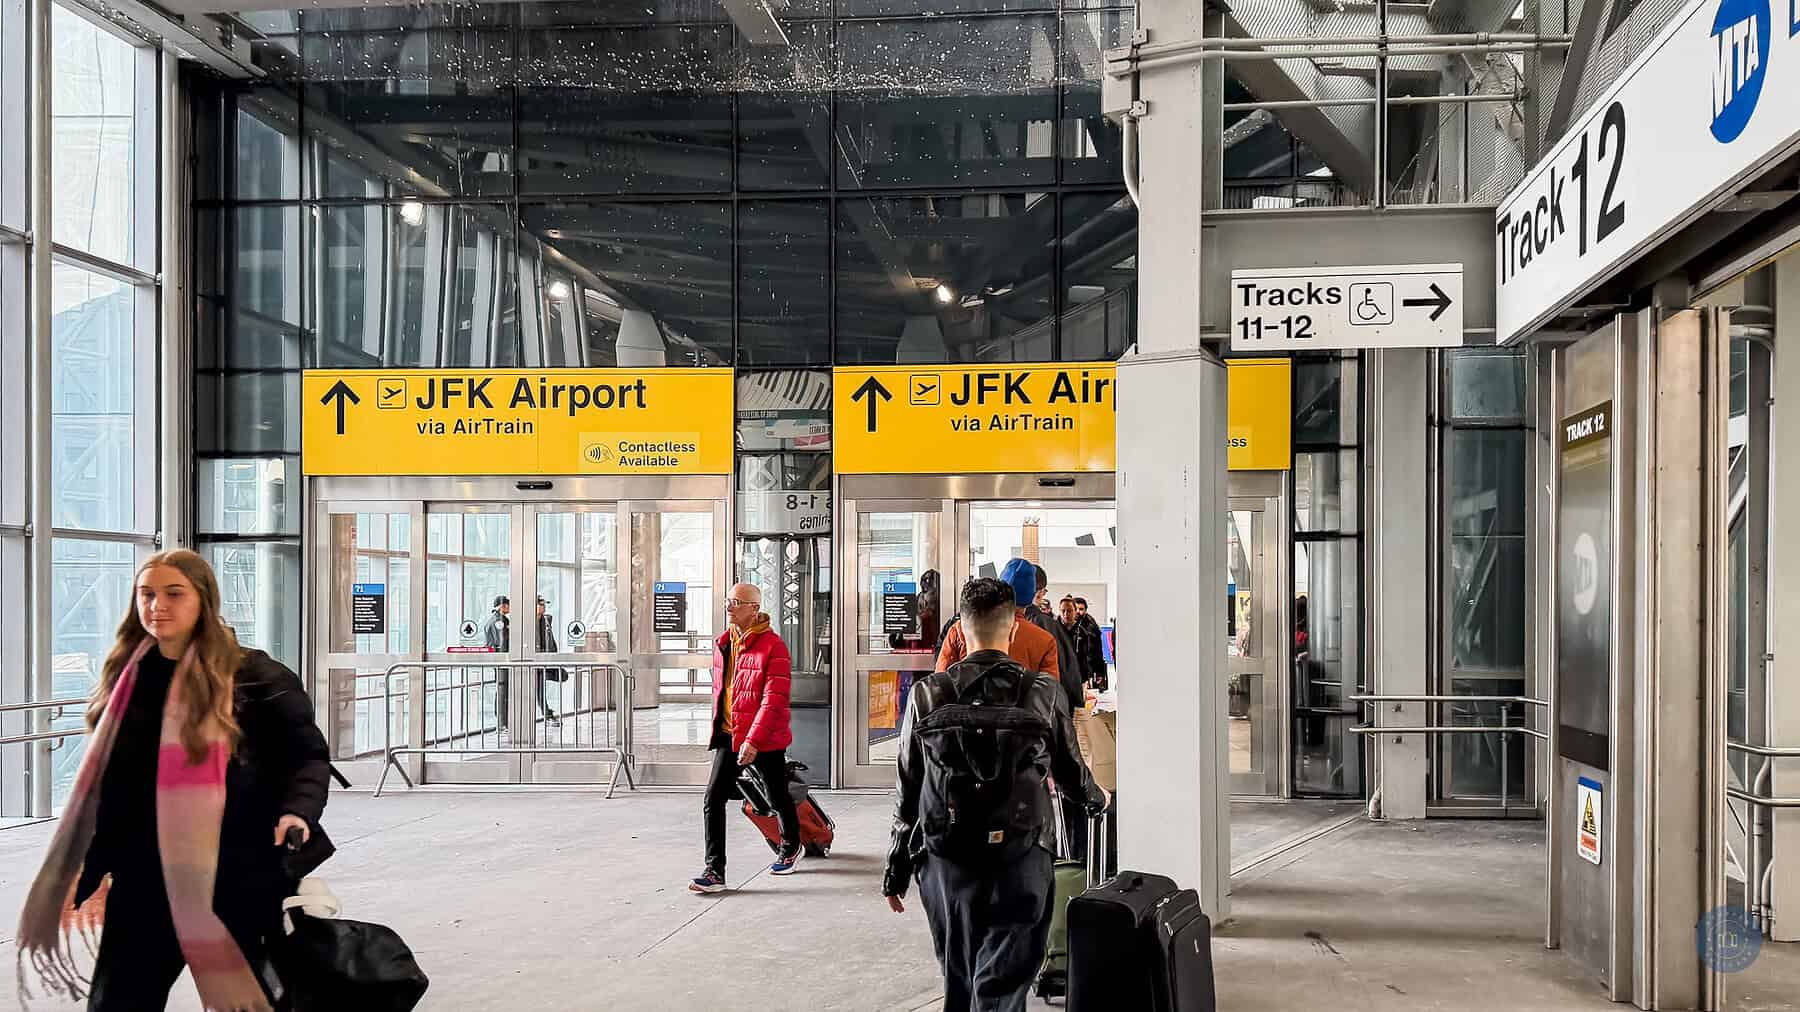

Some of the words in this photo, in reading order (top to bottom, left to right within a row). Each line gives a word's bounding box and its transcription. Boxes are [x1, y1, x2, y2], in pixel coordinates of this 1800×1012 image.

[1711, 14, 1759, 119] MTA
[1497, 166, 1565, 286] Track
[1571, 101, 1626, 258] 12
[1238, 282, 1342, 306] Tracks
[416, 378, 494, 409] JFK
[509, 377, 646, 416] Airport
[950, 372, 1033, 406] JFK
[416, 419, 445, 434] via
[453, 418, 533, 434] AirTrain
[951, 415, 980, 431] via
[988, 413, 1074, 431] AirTrain
[1566, 417, 1592, 442] TRACK
[1594, 413, 1604, 432] 12
[618, 441, 696, 453] Contactless
[618, 455, 679, 467] Available
